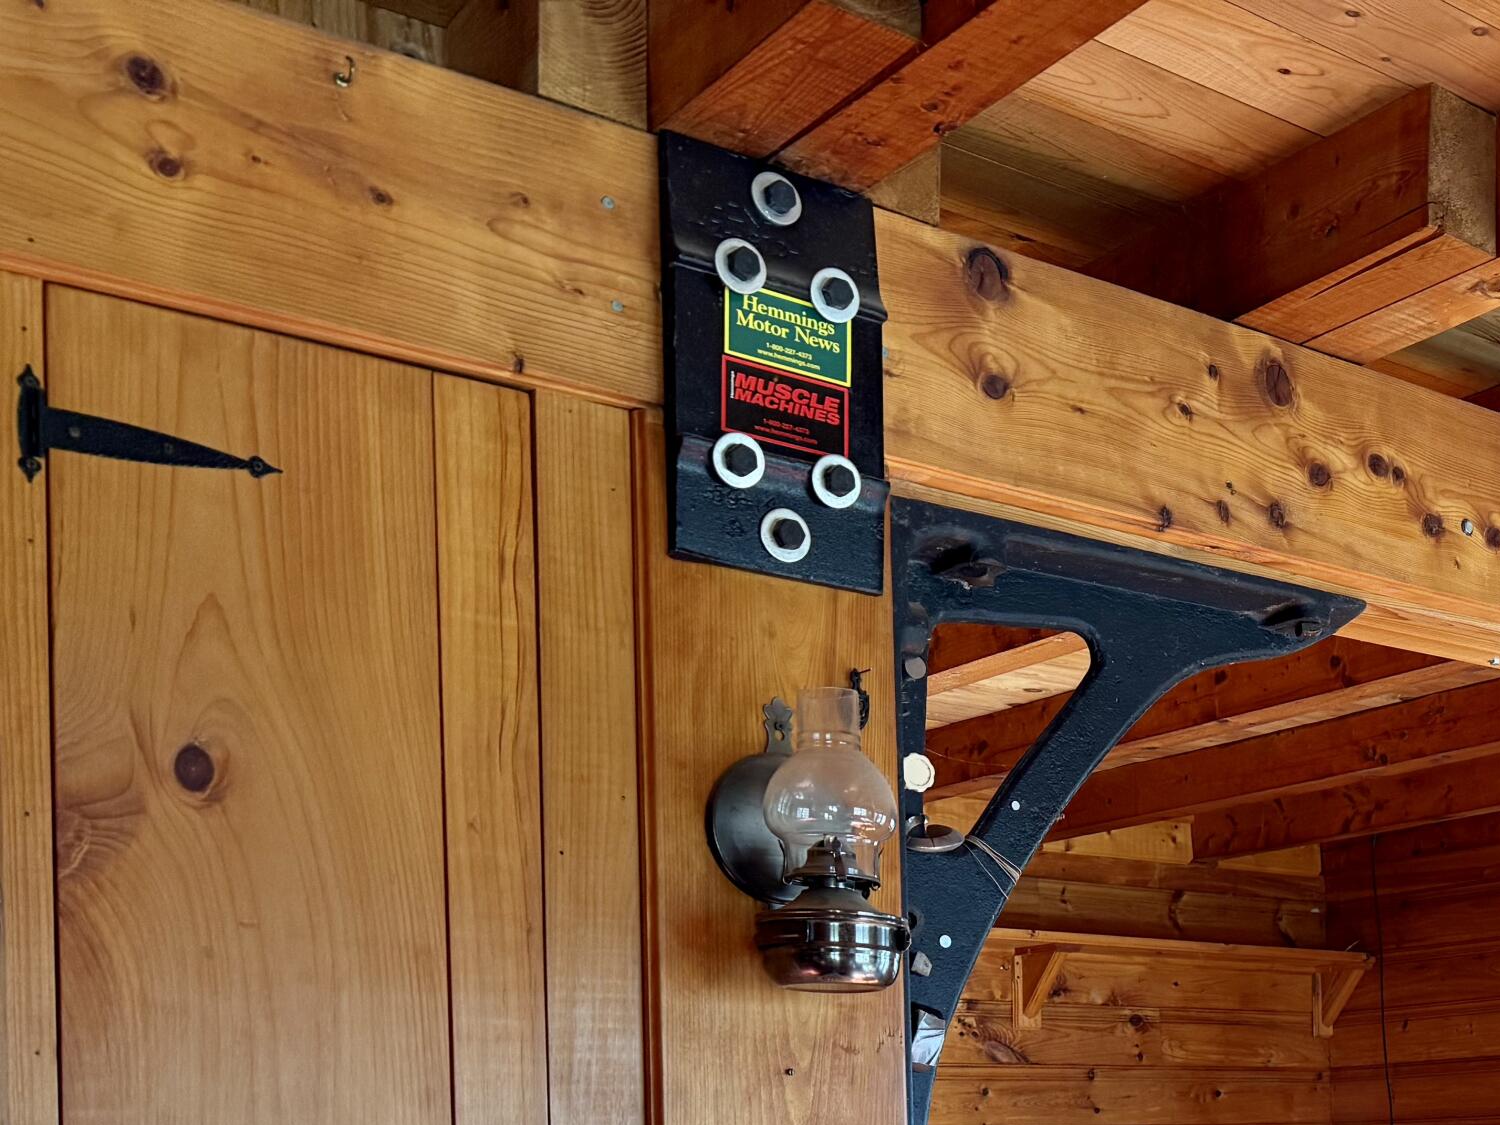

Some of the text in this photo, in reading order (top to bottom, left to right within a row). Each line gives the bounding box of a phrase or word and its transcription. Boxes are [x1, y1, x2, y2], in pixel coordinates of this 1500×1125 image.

[736, 309, 840, 354] Motor News
[743, 294, 835, 336] Hemmings
[735, 372, 840, 413] MUSCLE
[735, 388, 840, 426] MACHINES
